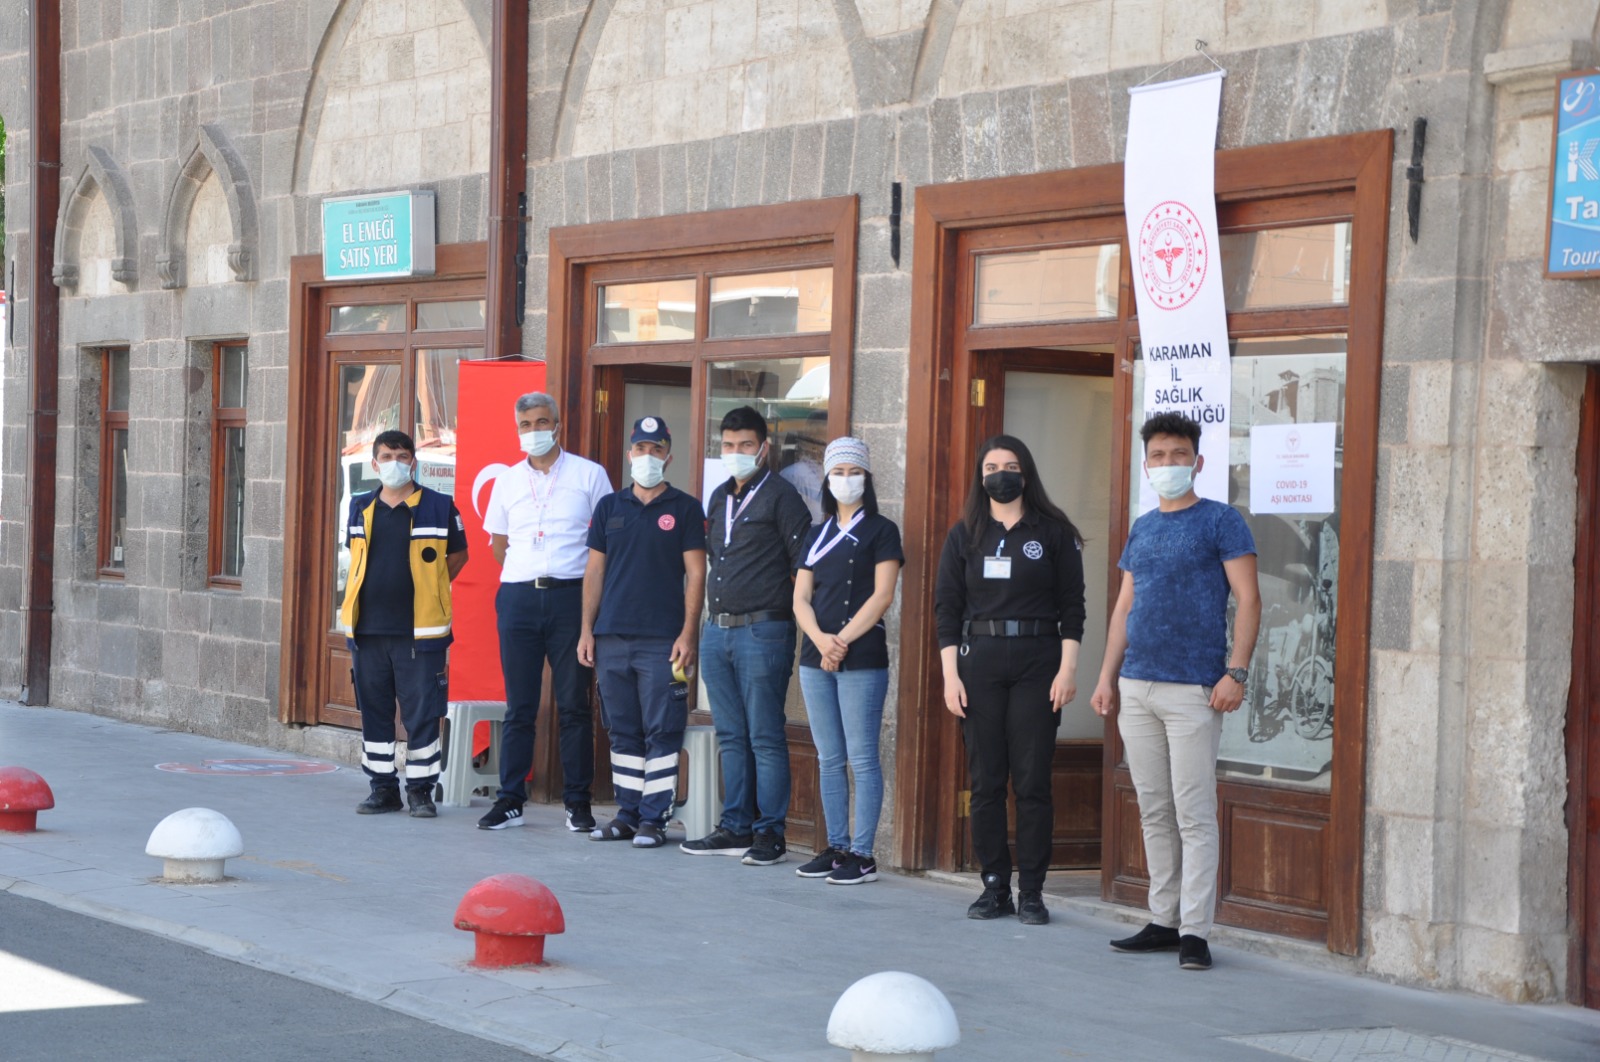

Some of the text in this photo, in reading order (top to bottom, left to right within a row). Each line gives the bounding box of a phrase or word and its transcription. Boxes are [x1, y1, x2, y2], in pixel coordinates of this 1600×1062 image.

[342, 214, 394, 244] EL EMEĞİ
[340, 240, 398, 272] SATIŞ YERİ
[1562, 249, 1600, 266] Tour
[1149, 342, 1212, 362] KARAMAN
[1170, 363, 1182, 382] İL
[1155, 385, 1203, 404] SAĞLIK
[1276, 480, 1308, 489] COVID-19
[1271, 494, 1312, 504] AŞI NOKTASI
